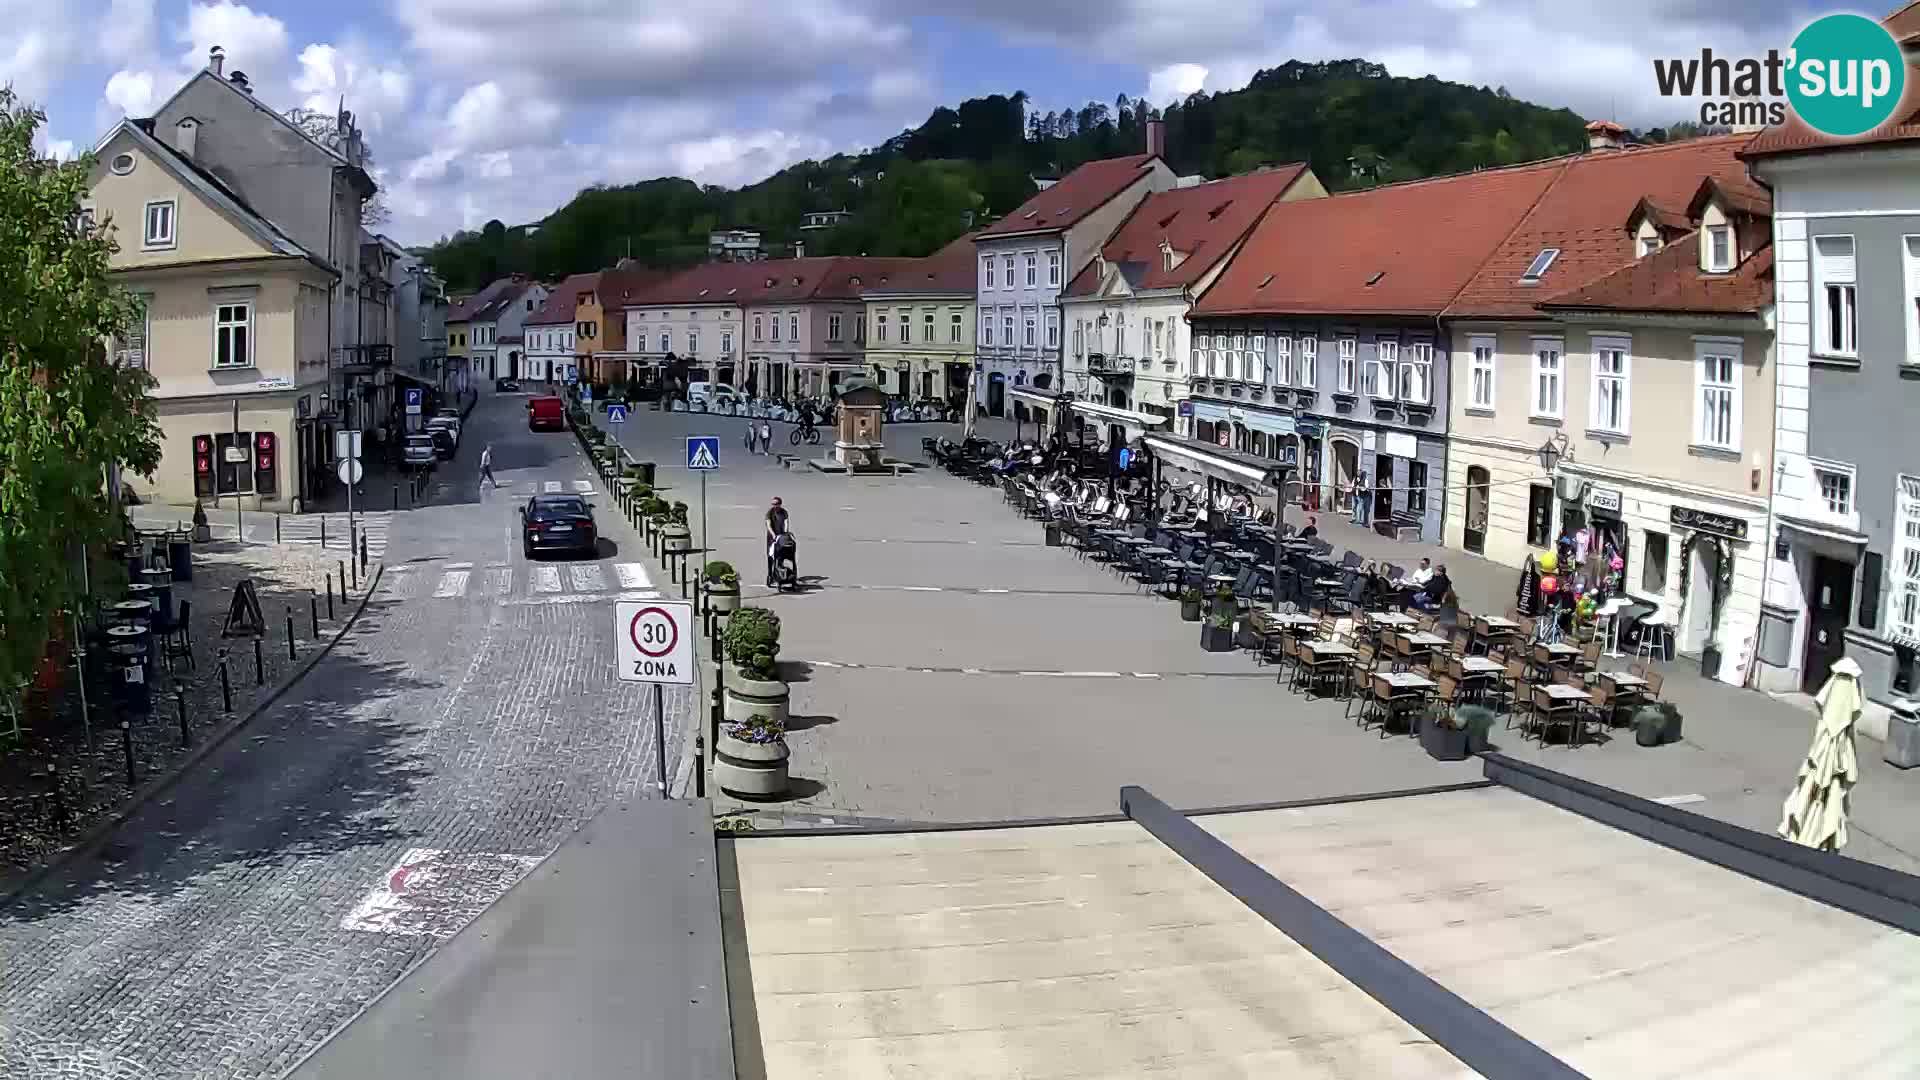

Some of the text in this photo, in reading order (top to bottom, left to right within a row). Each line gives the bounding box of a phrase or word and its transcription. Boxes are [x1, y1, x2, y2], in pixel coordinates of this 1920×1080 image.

[410, 391, 417, 402] P
[643, 623, 666, 644] 30
[633, 660, 677, 676] ZONA
